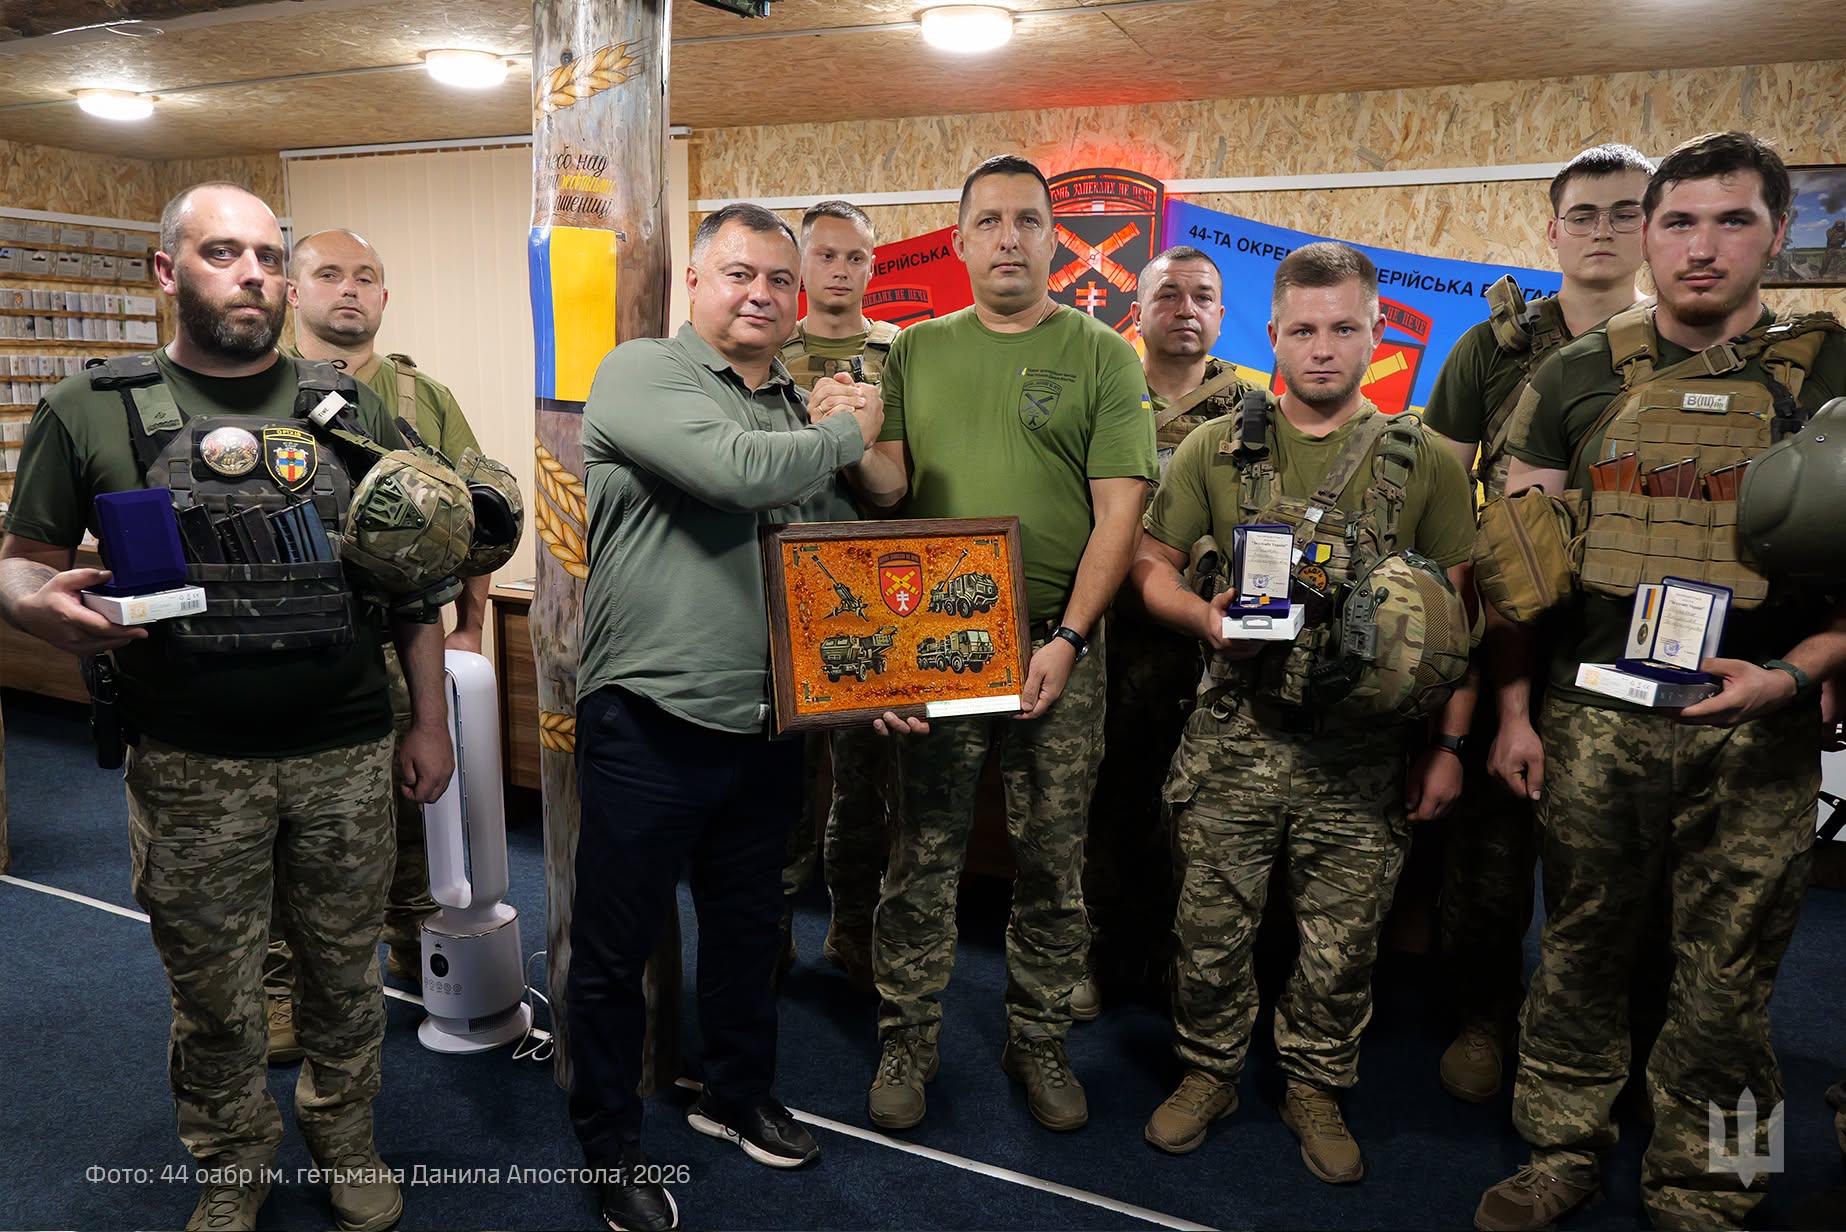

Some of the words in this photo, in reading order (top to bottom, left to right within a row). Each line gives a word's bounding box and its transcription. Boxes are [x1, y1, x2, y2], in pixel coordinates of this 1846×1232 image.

[576, 154, 609, 177] над
[1050, 186, 1070, 202] ГОНЬ
[1073, 181, 1115, 196] ЗАПЕКЛИХ
[1118, 183, 1129, 196] НЕ
[1132, 186, 1153, 203] ПЕЧЕ
[1189, 225, 1231, 248] 44-ТА
[1387, 306, 1400, 321] НЕ
[1402, 311, 1426, 334] ПЕЧЕ
